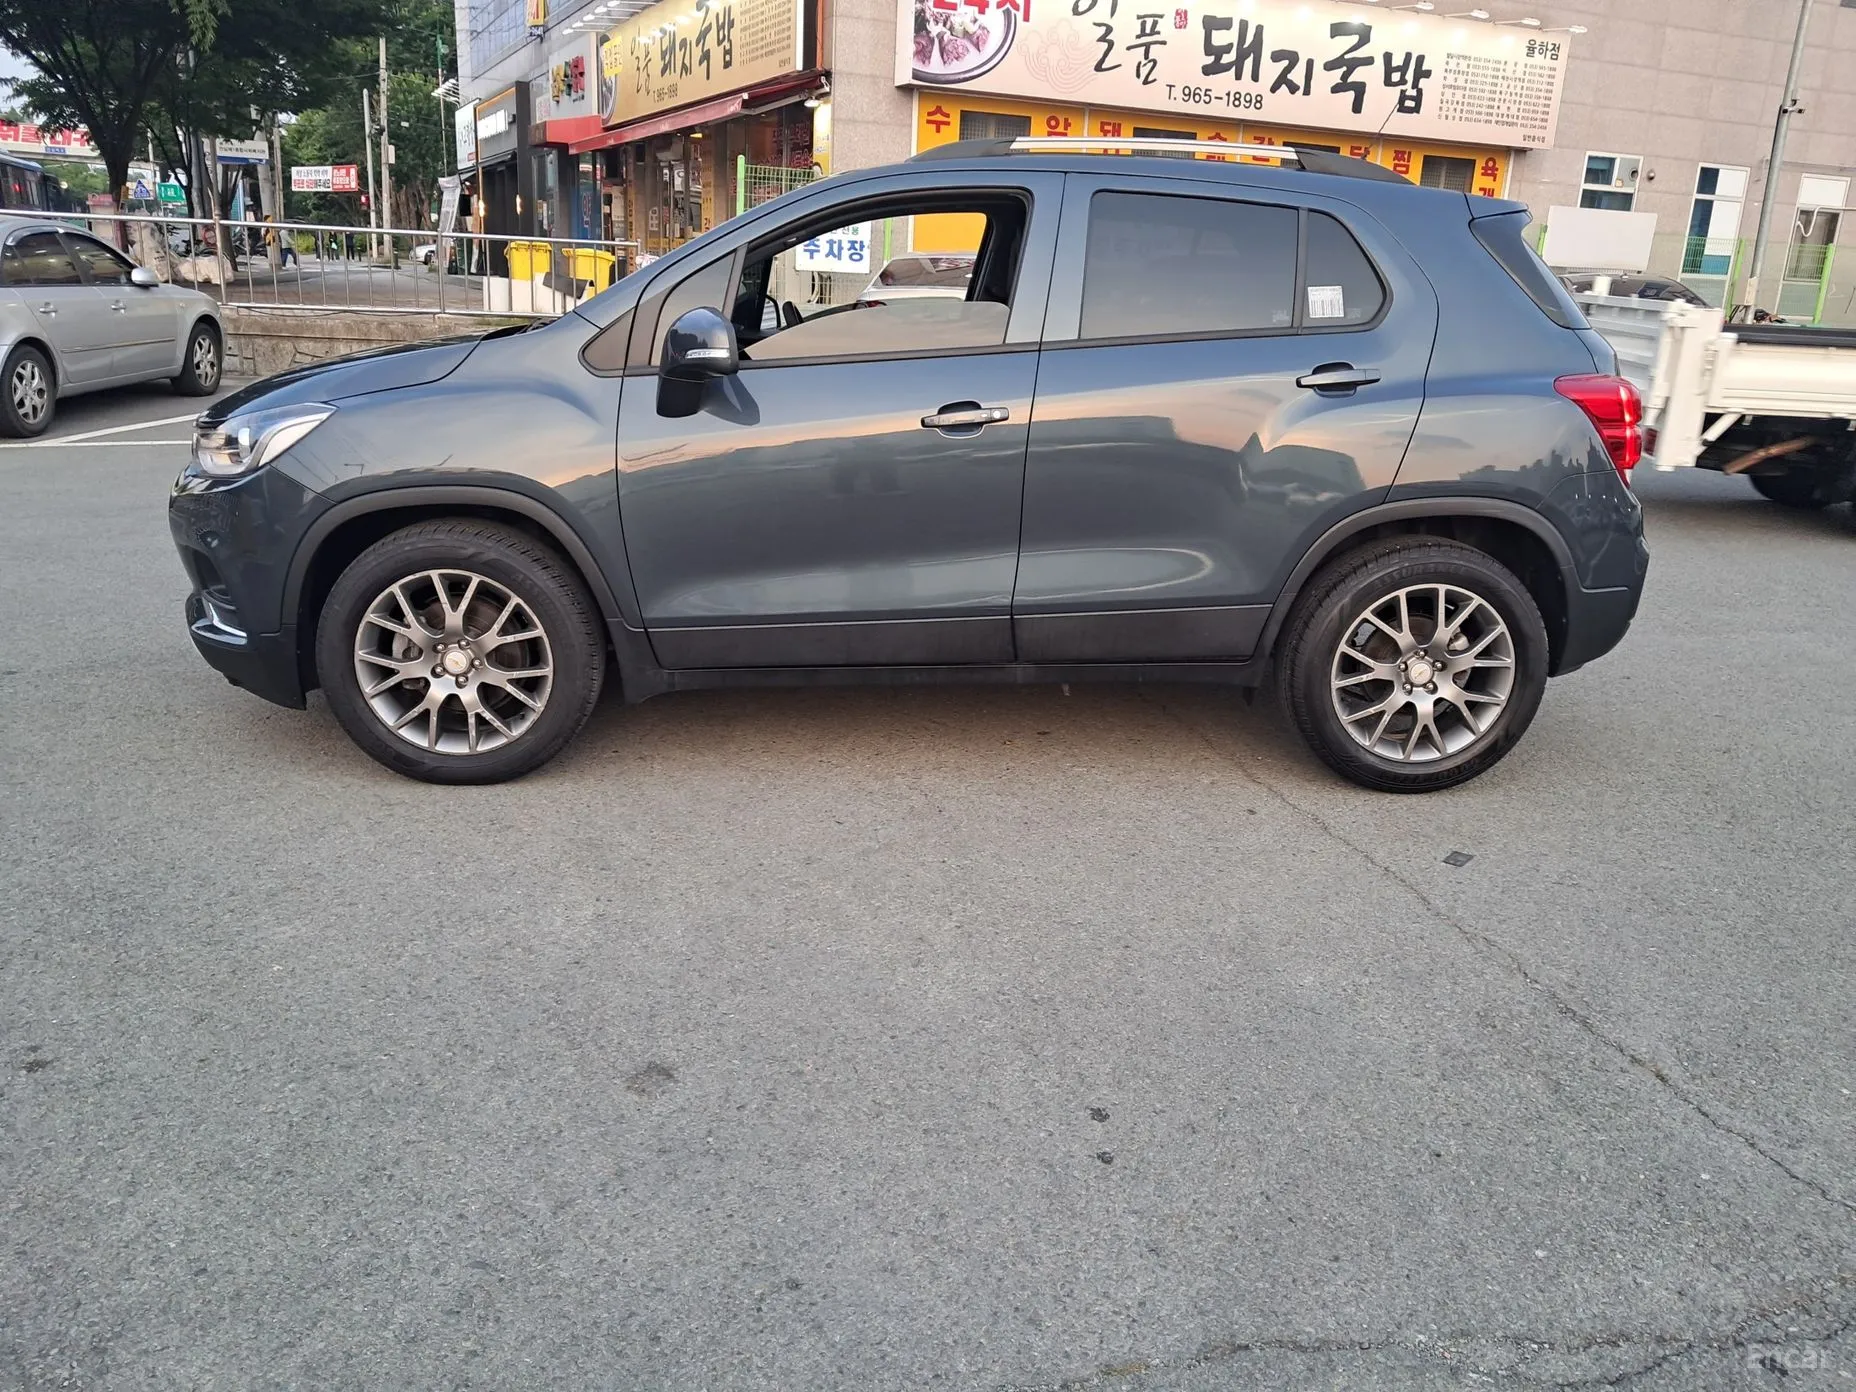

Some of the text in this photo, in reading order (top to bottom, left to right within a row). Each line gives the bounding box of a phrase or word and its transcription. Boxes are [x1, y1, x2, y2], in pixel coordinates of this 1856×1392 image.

[1525, 38, 1561, 61] 율하점
[1201, 14, 1433, 115] 돼지국밥
[1181, 86, 1264, 110] 965-1898
[803, 238, 866, 263] 주차장
